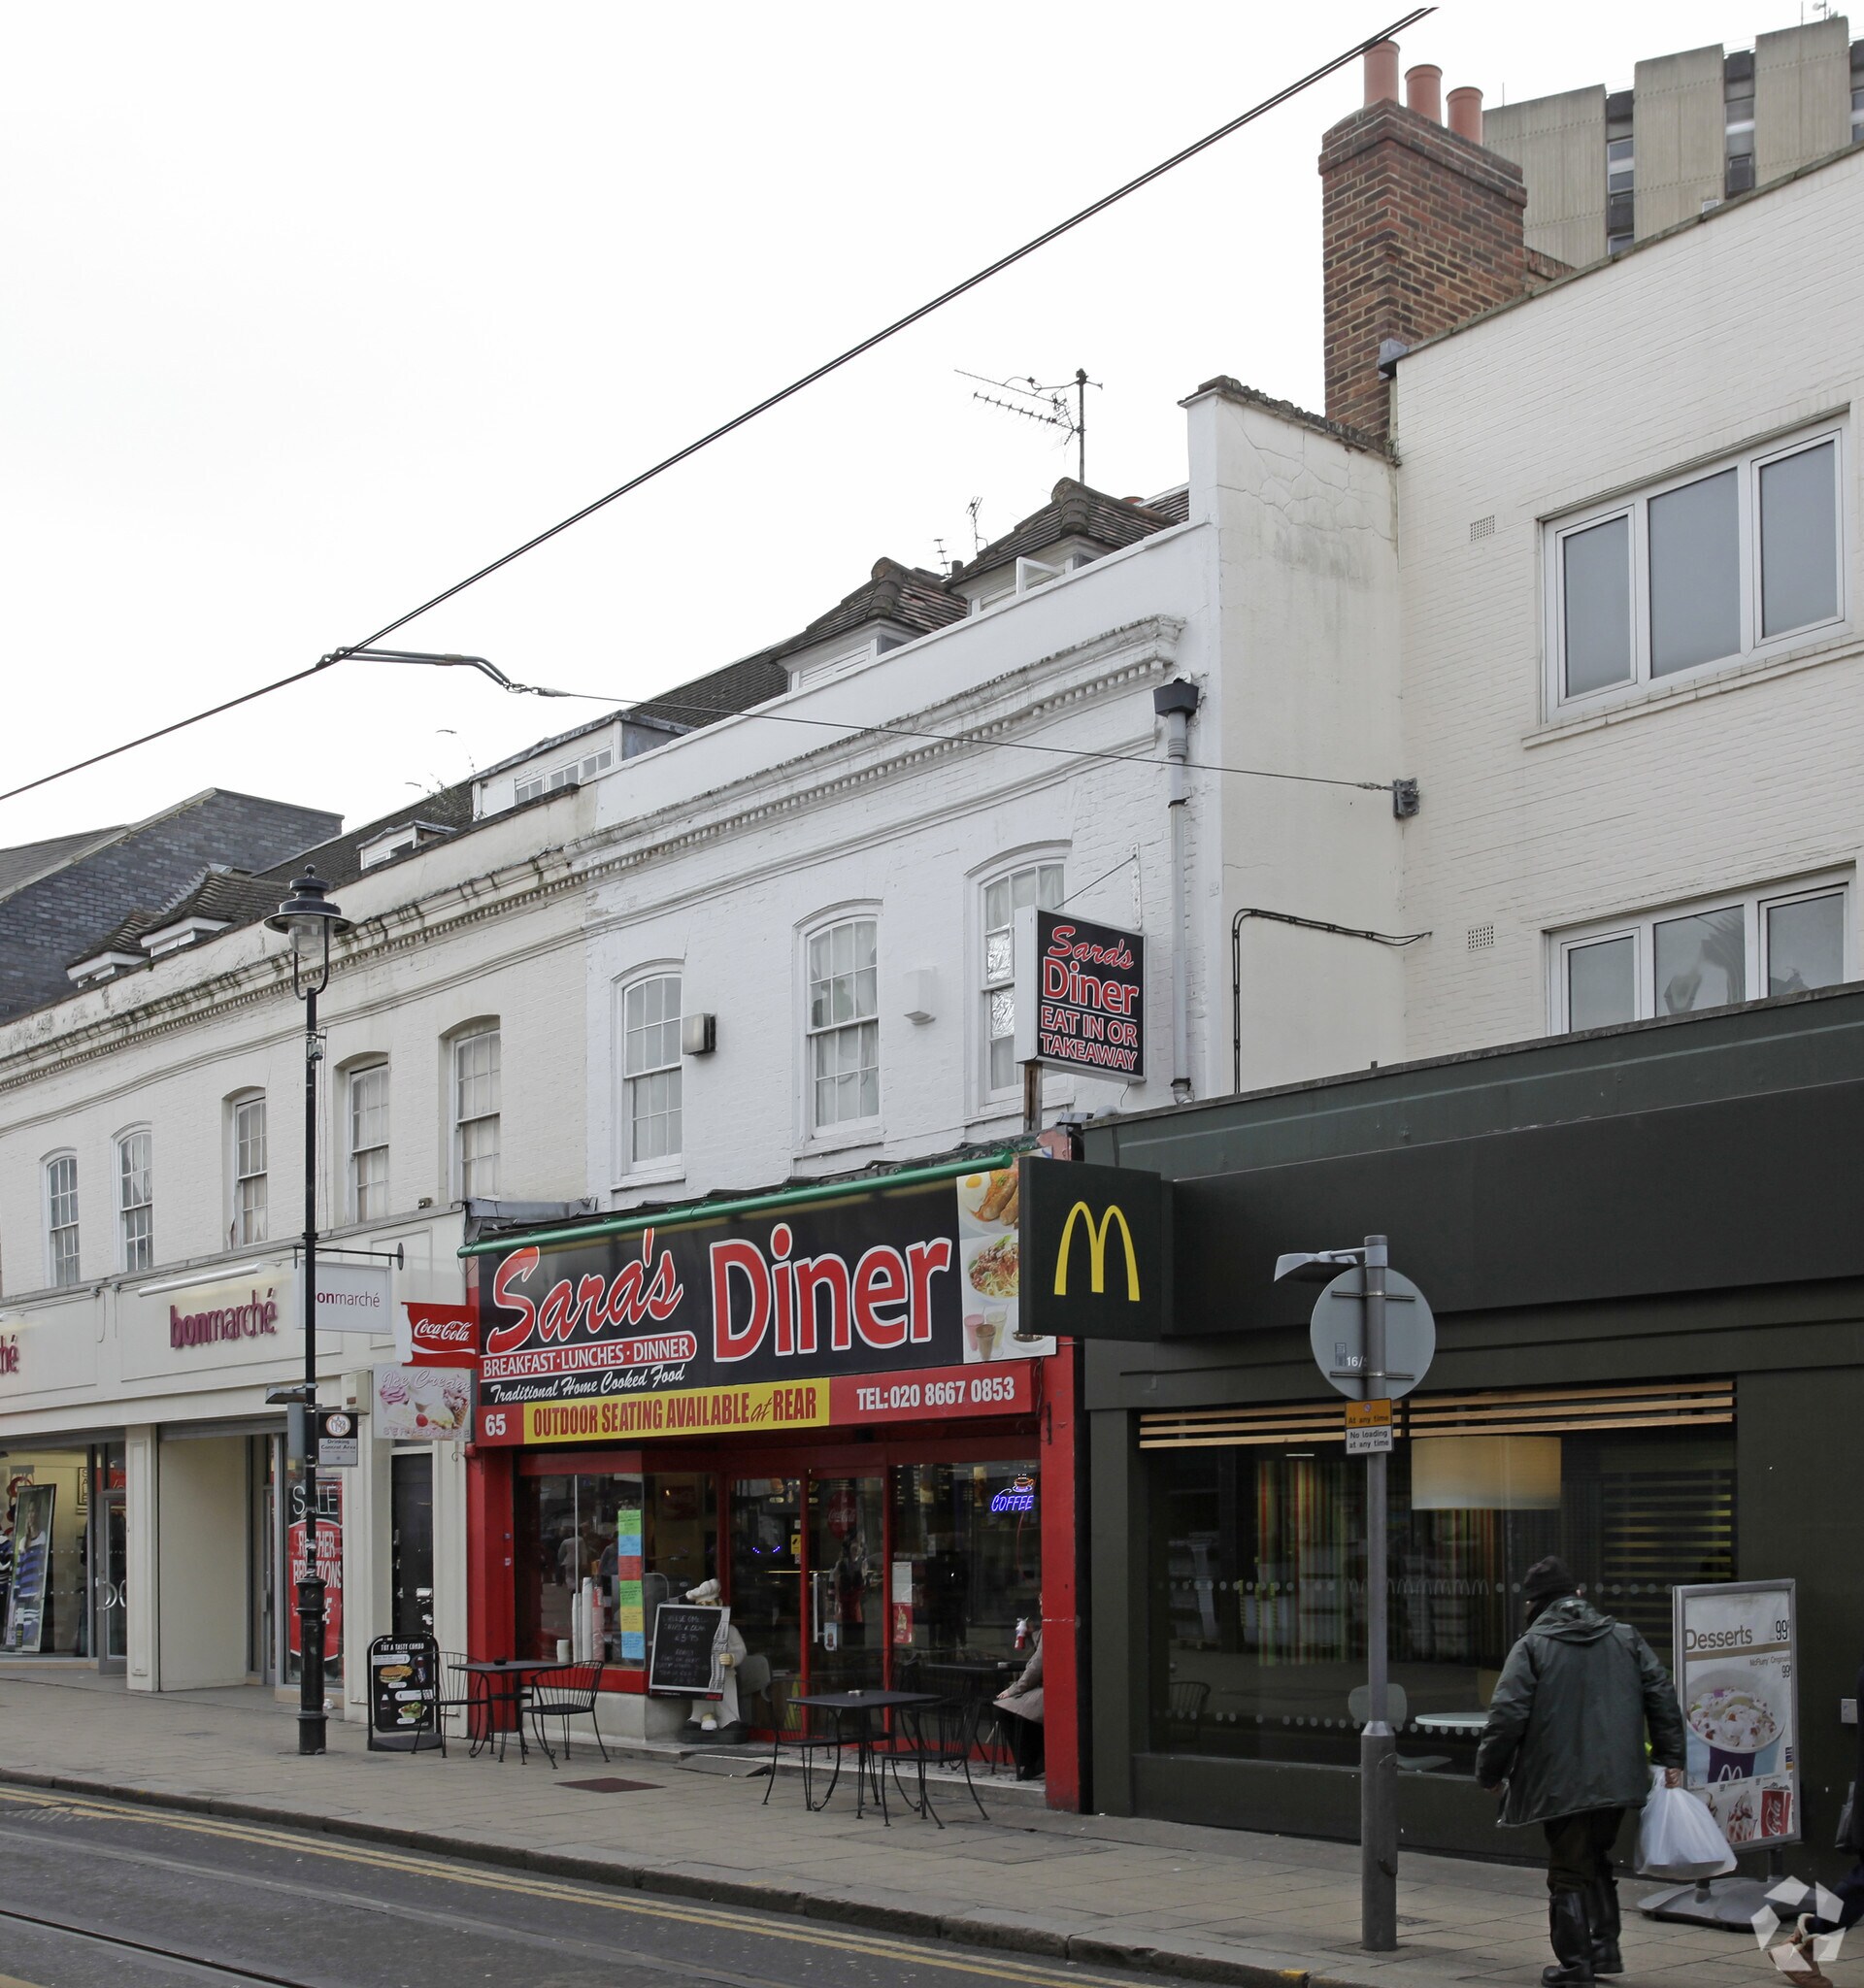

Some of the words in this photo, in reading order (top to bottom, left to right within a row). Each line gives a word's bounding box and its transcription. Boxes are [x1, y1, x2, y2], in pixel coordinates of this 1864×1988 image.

[1048, 925, 1134, 970] Sara's
[1043, 956, 1139, 1014] Diner
[1041, 1006, 1080, 1035] EAT
[1082, 1014, 1104, 1041] IN
[1107, 1020, 1138, 1047] OR
[1040, 1032, 1138, 1071] TAKEAWAY
[316, 1290, 380, 1308] onmarché
[486, 1228, 683, 1355] Sara's
[710, 1223, 952, 1363] Diner
[170, 1288, 278, 1348] bonmarché
[483, 1352, 556, 1376] BREAKFAST
[561, 1343, 623, 1370] LUNCHES
[633, 1338, 689, 1360] DINNER
[382, 1370, 410, 1389] Ice
[490, 1383, 558, 1404] Traditional
[561, 1375, 597, 1396] Home
[600, 1370, 648, 1394] Cooked
[650, 1364, 685, 1388] Food
[925, 1381, 966, 1407] 8667
[971, 1376, 1015, 1403] 0853
[485, 1413, 506, 1437] 65
[534, 1402, 598, 1438] OUTDOOR
[601, 1399, 663, 1434] SEATING
[666, 1392, 749, 1429] AVAILABLE
[750, 1396, 773, 1423] at
[773, 1387, 816, 1421] REAR
[1359, 1416, 1370, 1425] any
[1362, 1429, 1388, 1438] loading
[292, 1485, 339, 1515] SLE
[991, 1489, 1034, 1512] COFFEE
[1685, 1625, 1752, 1650] Desserts
